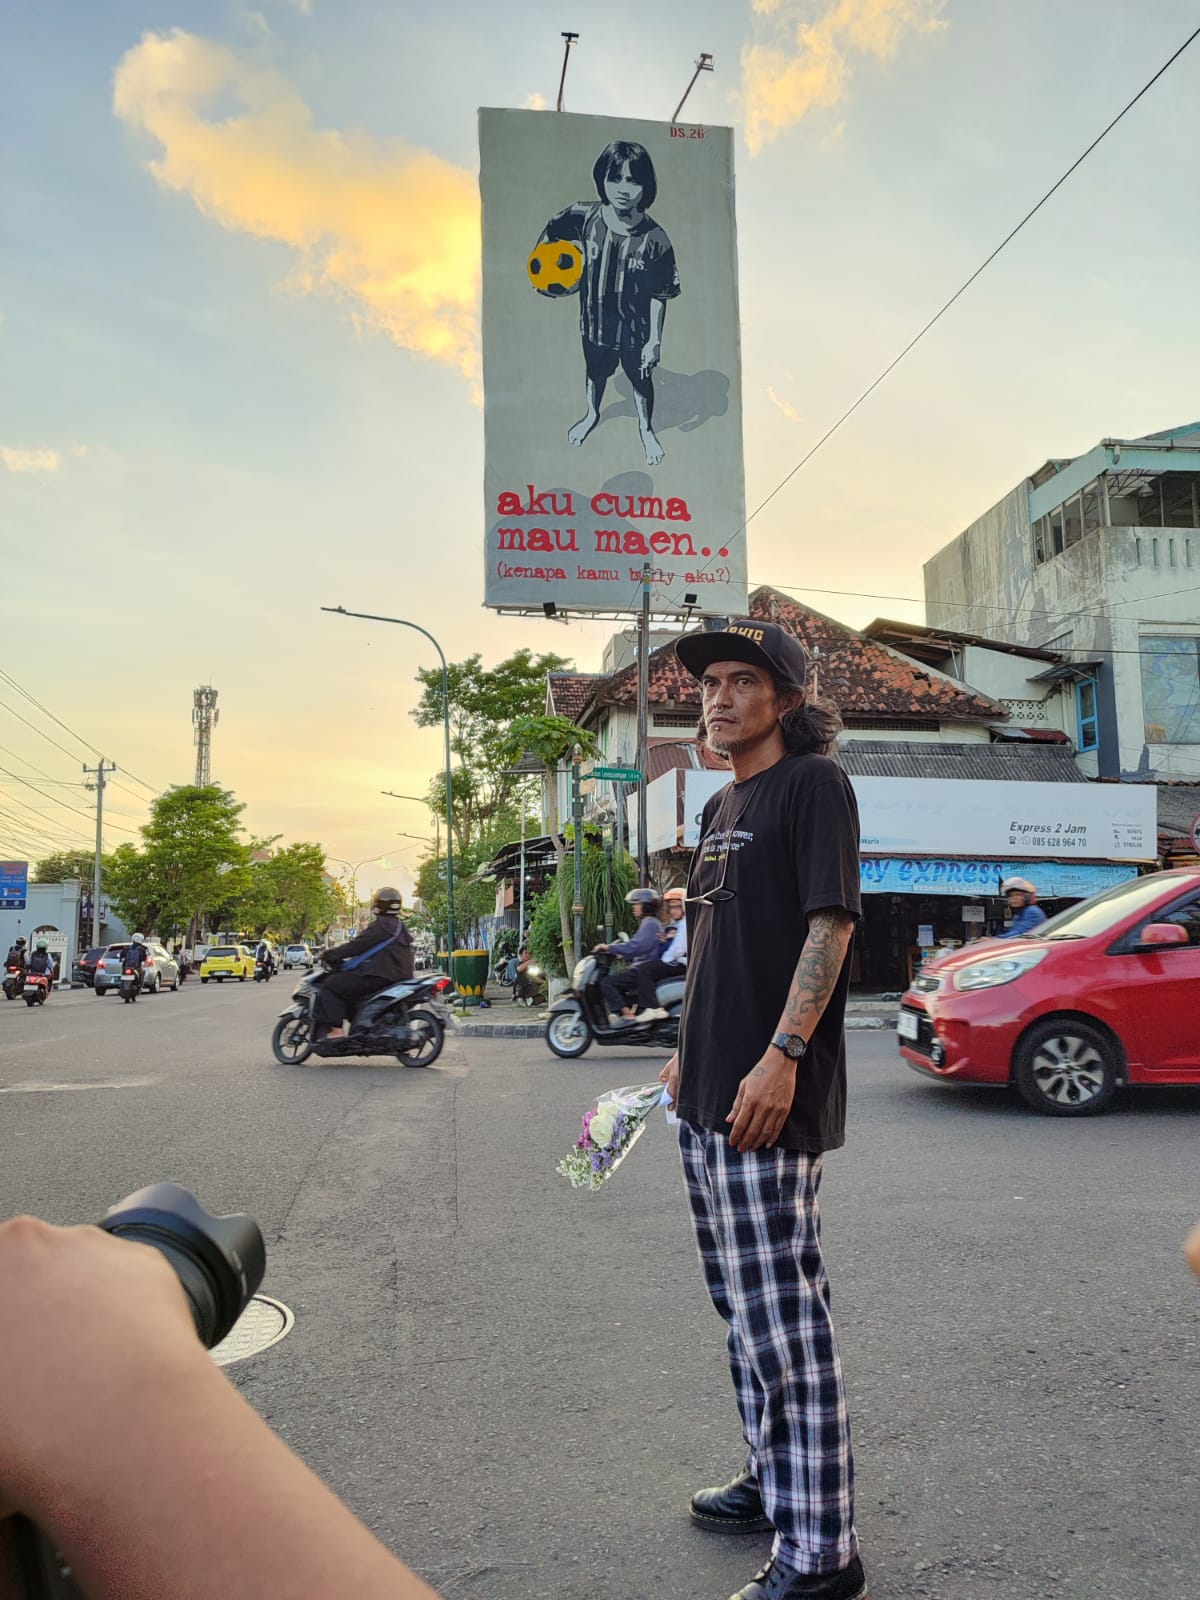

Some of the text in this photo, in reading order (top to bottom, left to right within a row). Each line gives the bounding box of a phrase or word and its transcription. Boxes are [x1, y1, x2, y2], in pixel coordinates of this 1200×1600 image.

[670, 127, 705, 139] DS.26
[497, 484, 692, 521] aku cuma
[497, 527, 729, 557] mau maen..
[497, 560, 566, 583] (kenapa
[576, 565, 620, 581] kamu
[684, 566, 731, 585] aku?)
[1010, 821, 1087, 834] Express 2 Jam
[1032, 837, 1087, 847] 085 628 964 70
